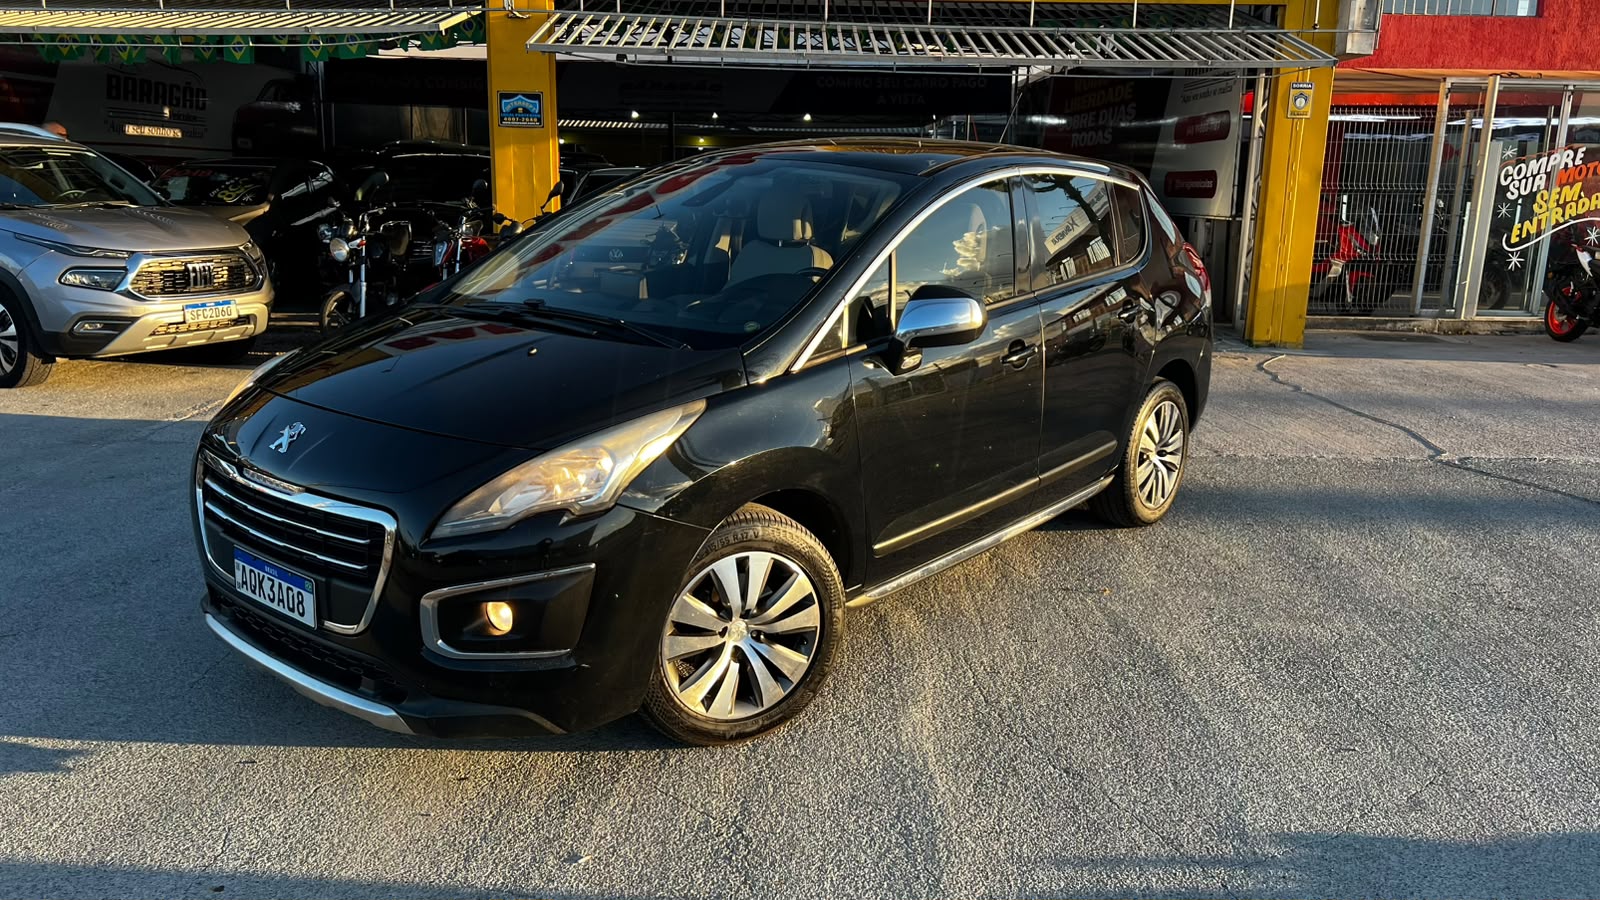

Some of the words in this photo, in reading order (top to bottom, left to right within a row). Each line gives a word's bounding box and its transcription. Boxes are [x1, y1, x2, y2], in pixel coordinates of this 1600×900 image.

[106, 74, 207, 110] BARAGÃO
[1064, 81, 1136, 113] LIBERDADE
[132, 127, 145, 135] seu
[147, 125, 171, 136] sonho
[1072, 129, 1112, 148] RODAS
[1500, 146, 1587, 186] COMPRE
[1506, 173, 1547, 200] SUA
[1533, 181, 1583, 214] SEM
[1510, 192, 1600, 244] ENTRADA
[265, 565, 279, 577] BRASIL
[241, 565, 306, 618] AQK3A08
